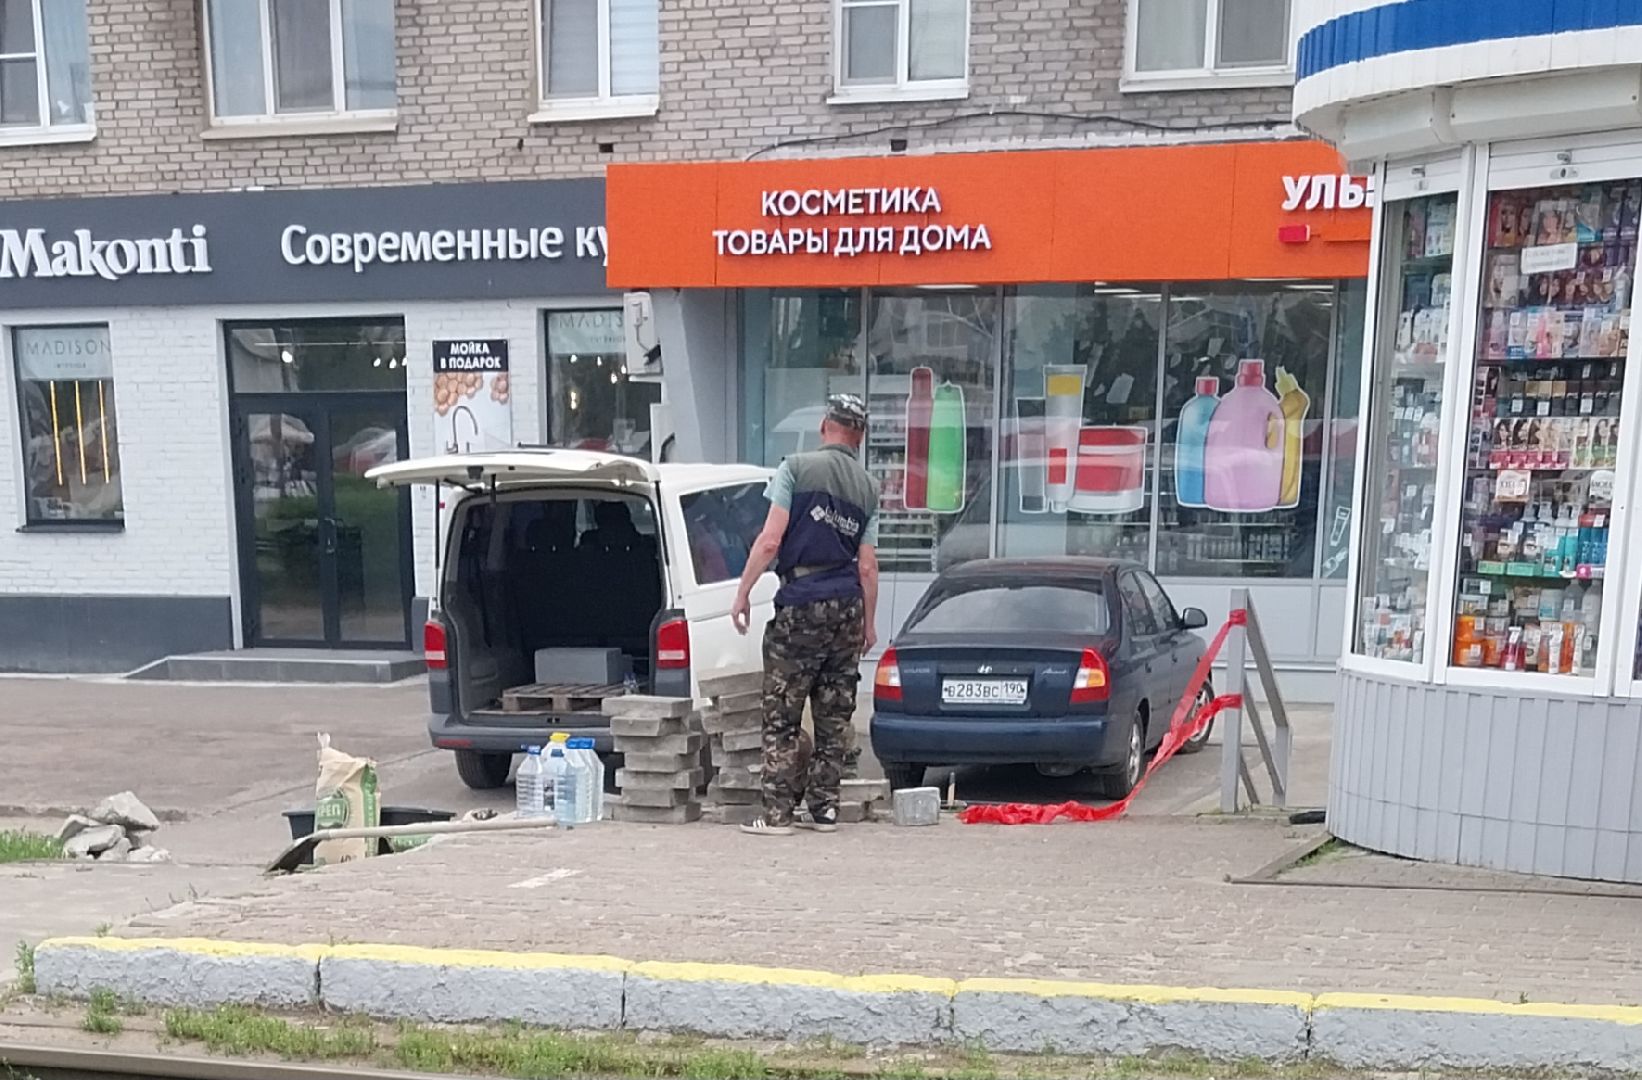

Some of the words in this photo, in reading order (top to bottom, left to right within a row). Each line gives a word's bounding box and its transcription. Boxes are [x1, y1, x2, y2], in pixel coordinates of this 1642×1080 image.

[761, 187, 942, 216] КОСМЕТИКА
[281, 224, 564, 273] Современные
[712, 228, 828, 255] ТОВАРЫ
[834, 226, 893, 257] ДЛЯ
[900, 223, 992, 256] ДОМА
[0, 224, 213, 280] Makonti
[25, 339, 111, 355] MADISON
[450, 341, 490, 355] МОЙКА
[440, 357, 447, 369] В
[448, 356, 502, 369] ПОДАРОК
[1004, 682, 1022, 695] 190
